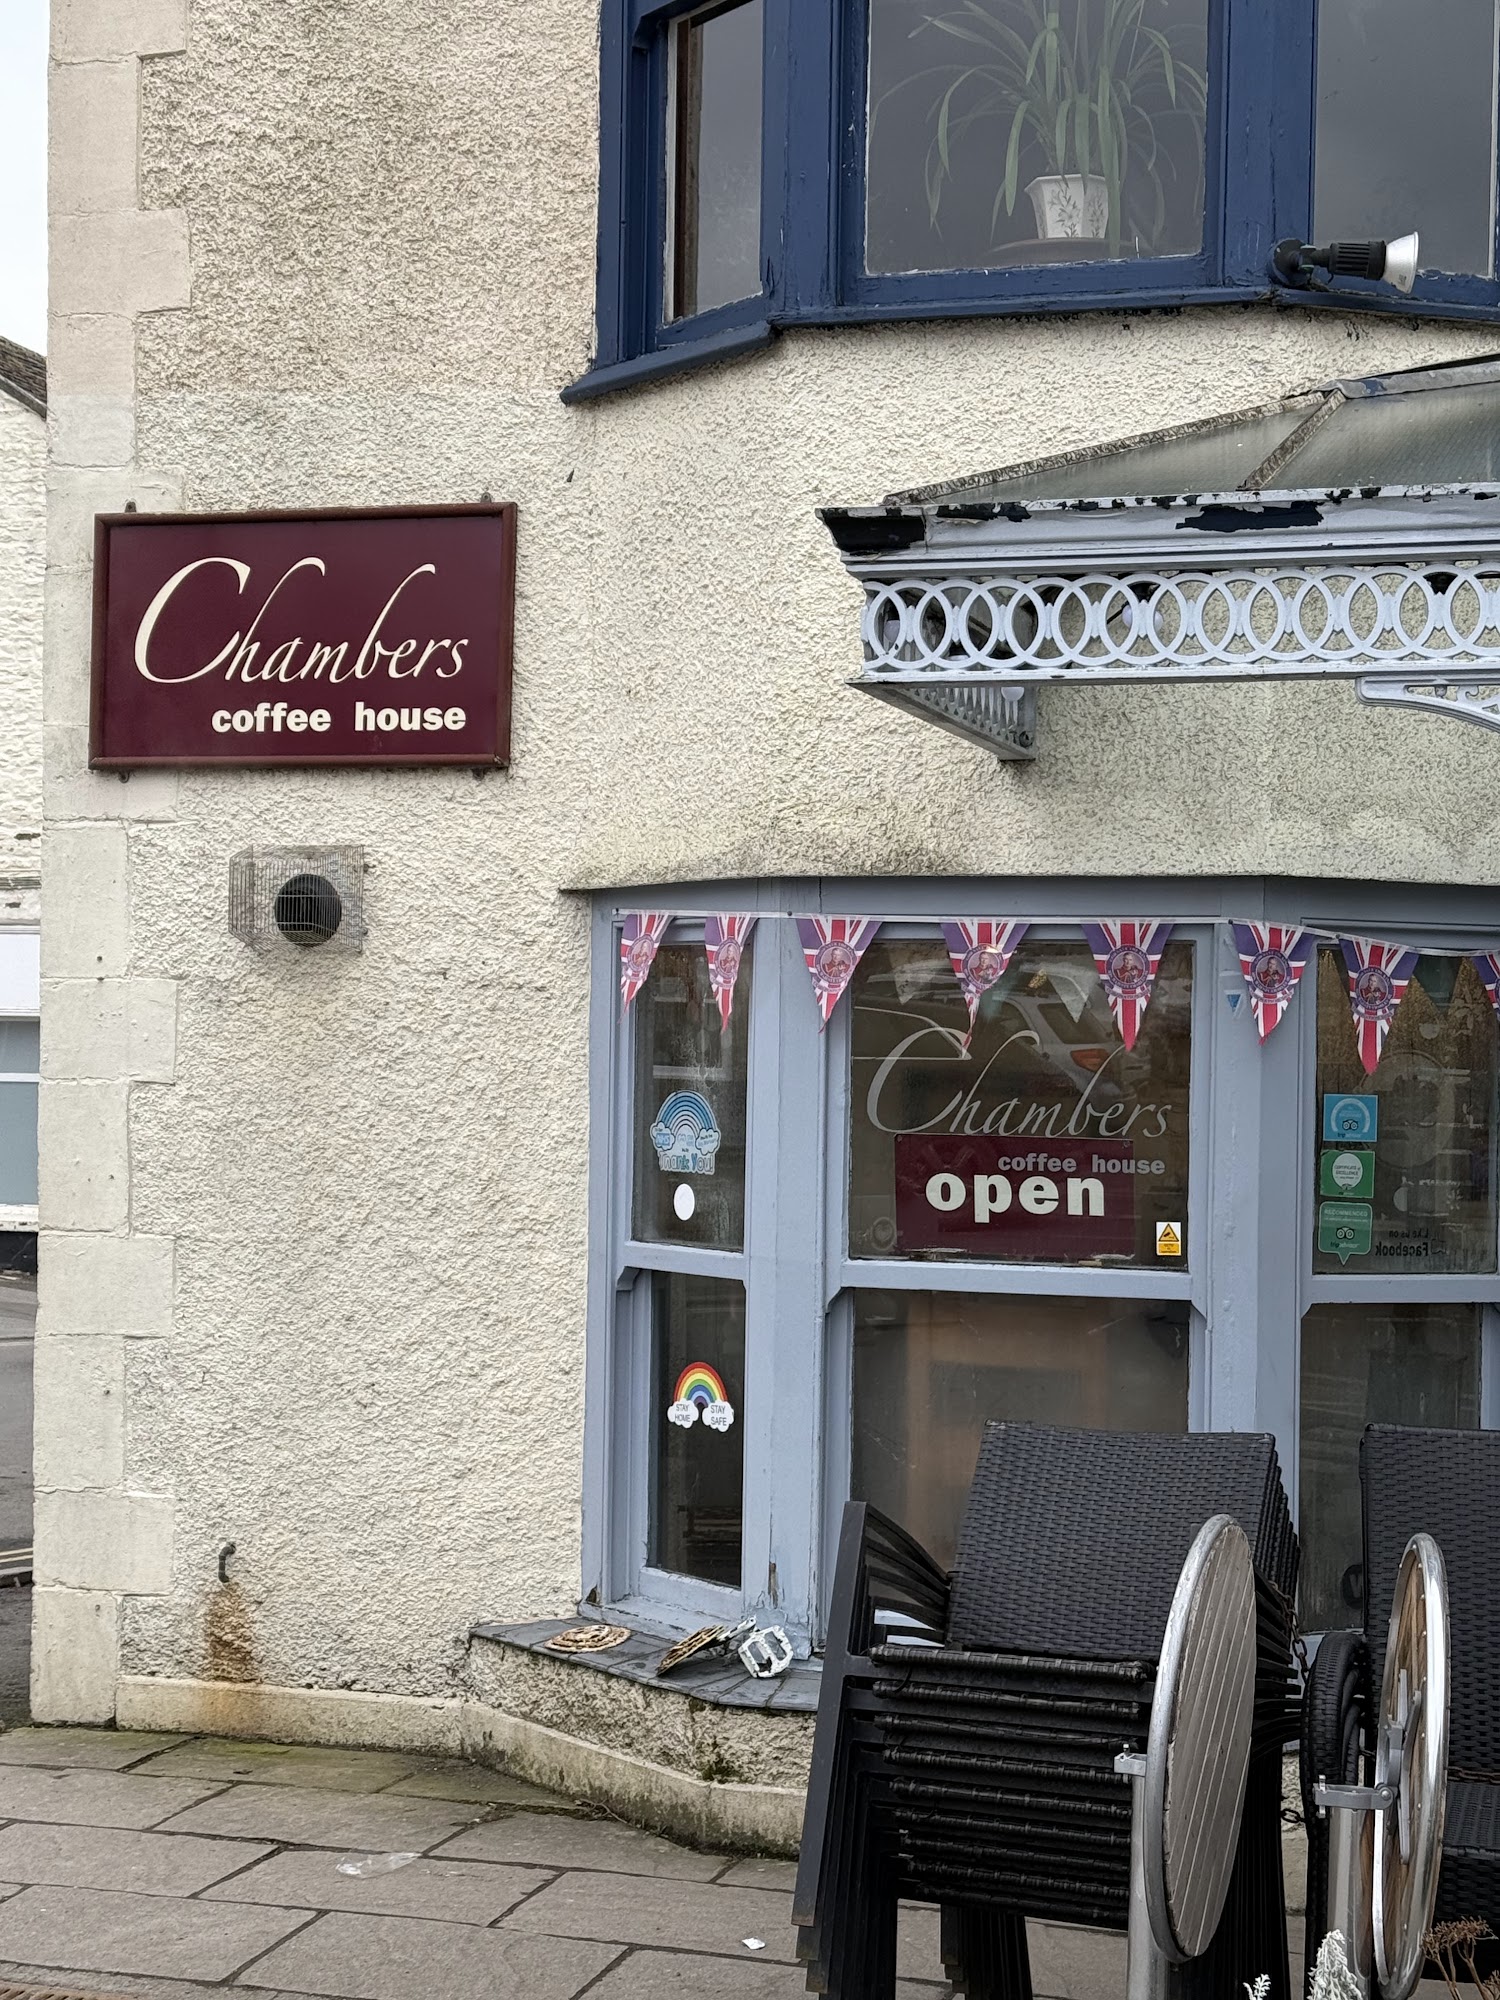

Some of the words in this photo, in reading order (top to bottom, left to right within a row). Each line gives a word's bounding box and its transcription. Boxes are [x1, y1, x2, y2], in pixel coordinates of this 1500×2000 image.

[134, 557, 469, 684] Chambers
[211, 703, 332, 733] coffee
[354, 701, 467, 732] house
[866, 1027, 1172, 1137] Chambers
[997, 1153, 1077, 1173] coffee
[1091, 1155, 1166, 1175] house
[925, 1171, 1105, 1224] open
[674, 1414, 691, 1422] HOME
[676, 1404, 690, 1412] STAY
[710, 1405, 726, 1414] STAY
[710, 1416, 727, 1426] SAFE
